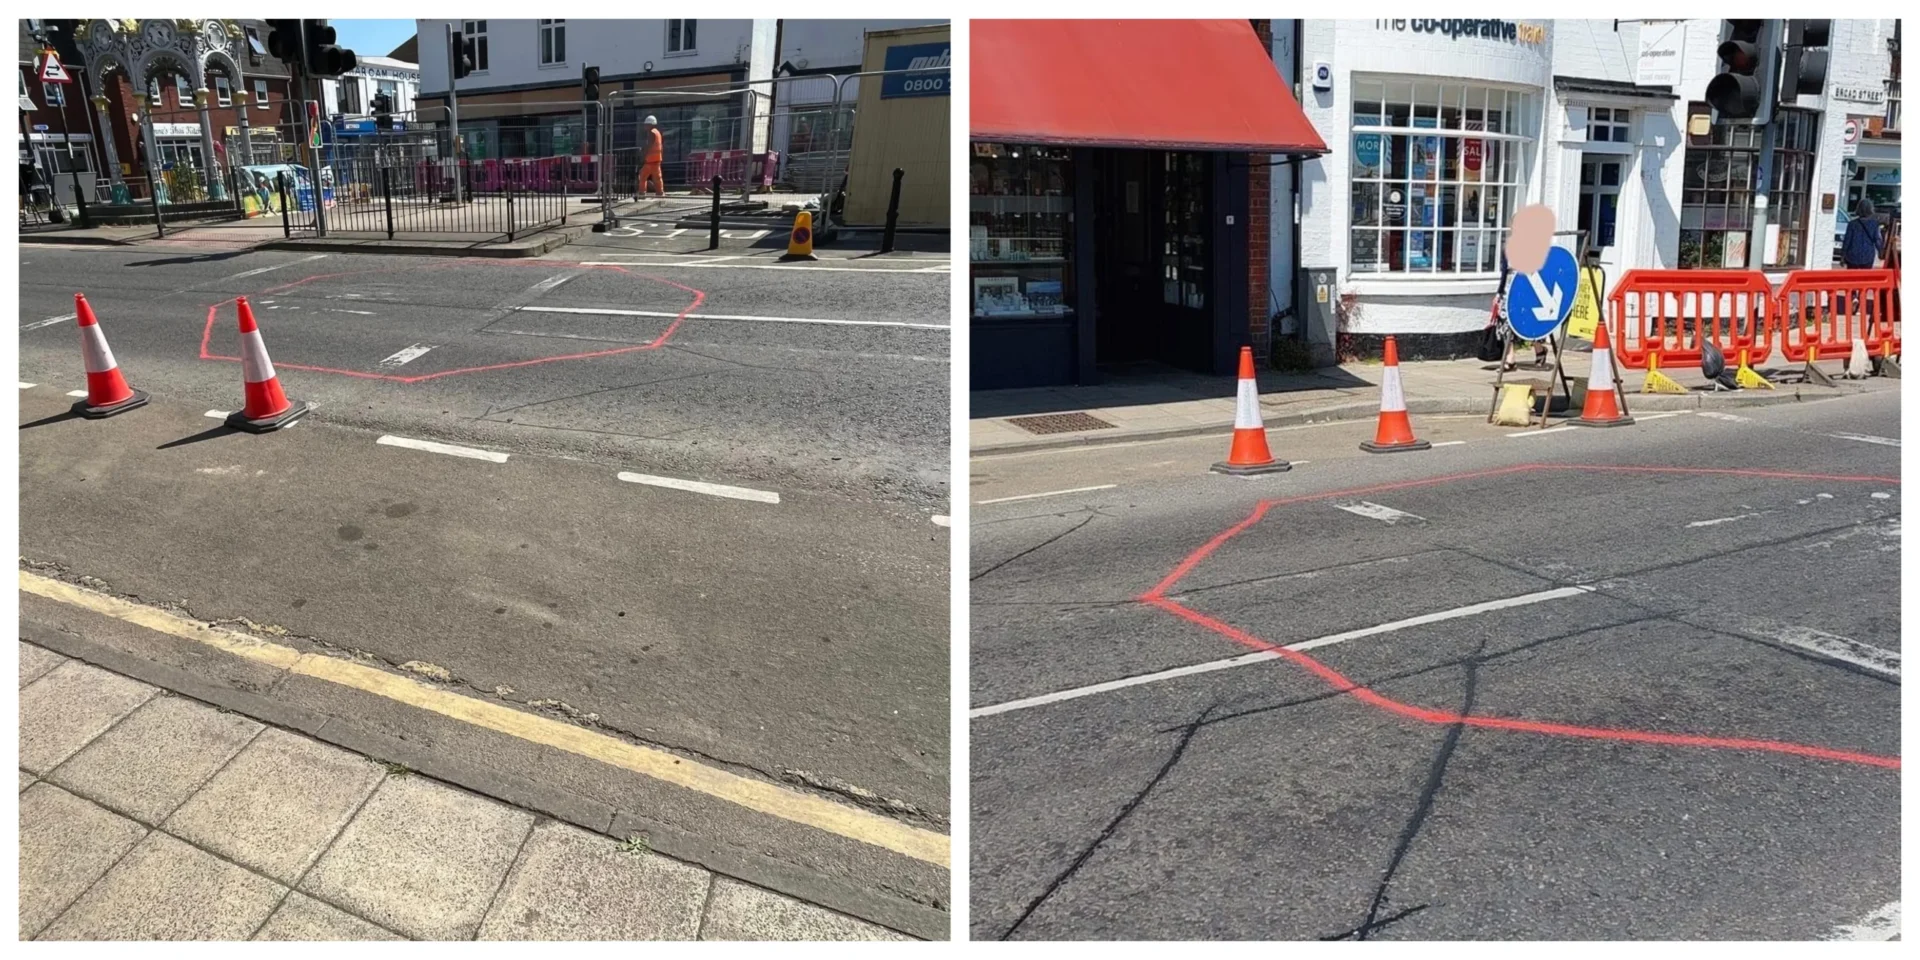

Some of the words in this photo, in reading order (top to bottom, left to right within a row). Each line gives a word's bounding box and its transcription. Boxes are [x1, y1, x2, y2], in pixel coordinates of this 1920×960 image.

[1411, 18, 1517, 41] co-operative
[907, 48, 951, 71] mob
[392, 72, 420, 81] HOUSE
[903, 78, 943, 92] 0800
[1835, 87, 1857, 99] BROAD
[1858, 90, 1883, 102] STREET
[1357, 140, 1380, 151] MOR
[1463, 146, 1481, 157] SAL
